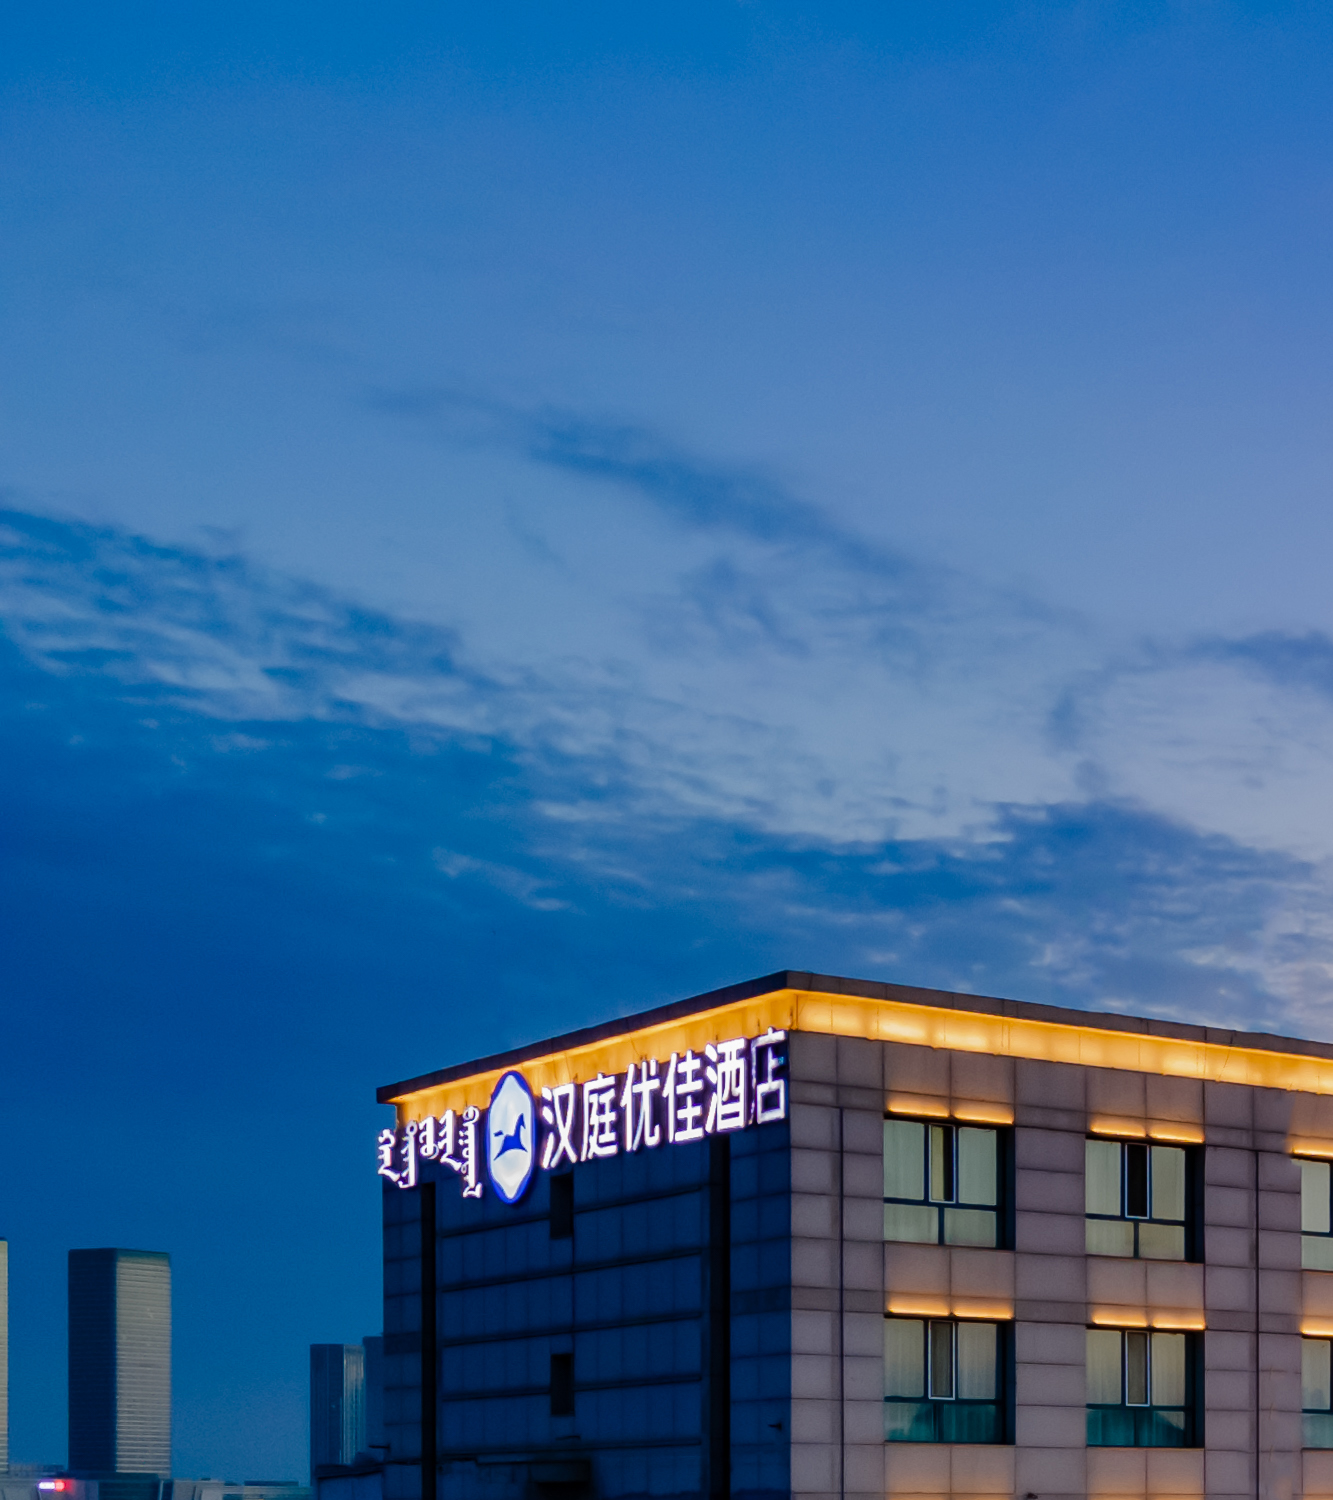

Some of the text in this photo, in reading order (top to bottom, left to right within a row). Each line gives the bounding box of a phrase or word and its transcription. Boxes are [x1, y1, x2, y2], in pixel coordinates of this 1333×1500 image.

[541, 1026, 788, 1170] 汉庭优佳酒店
